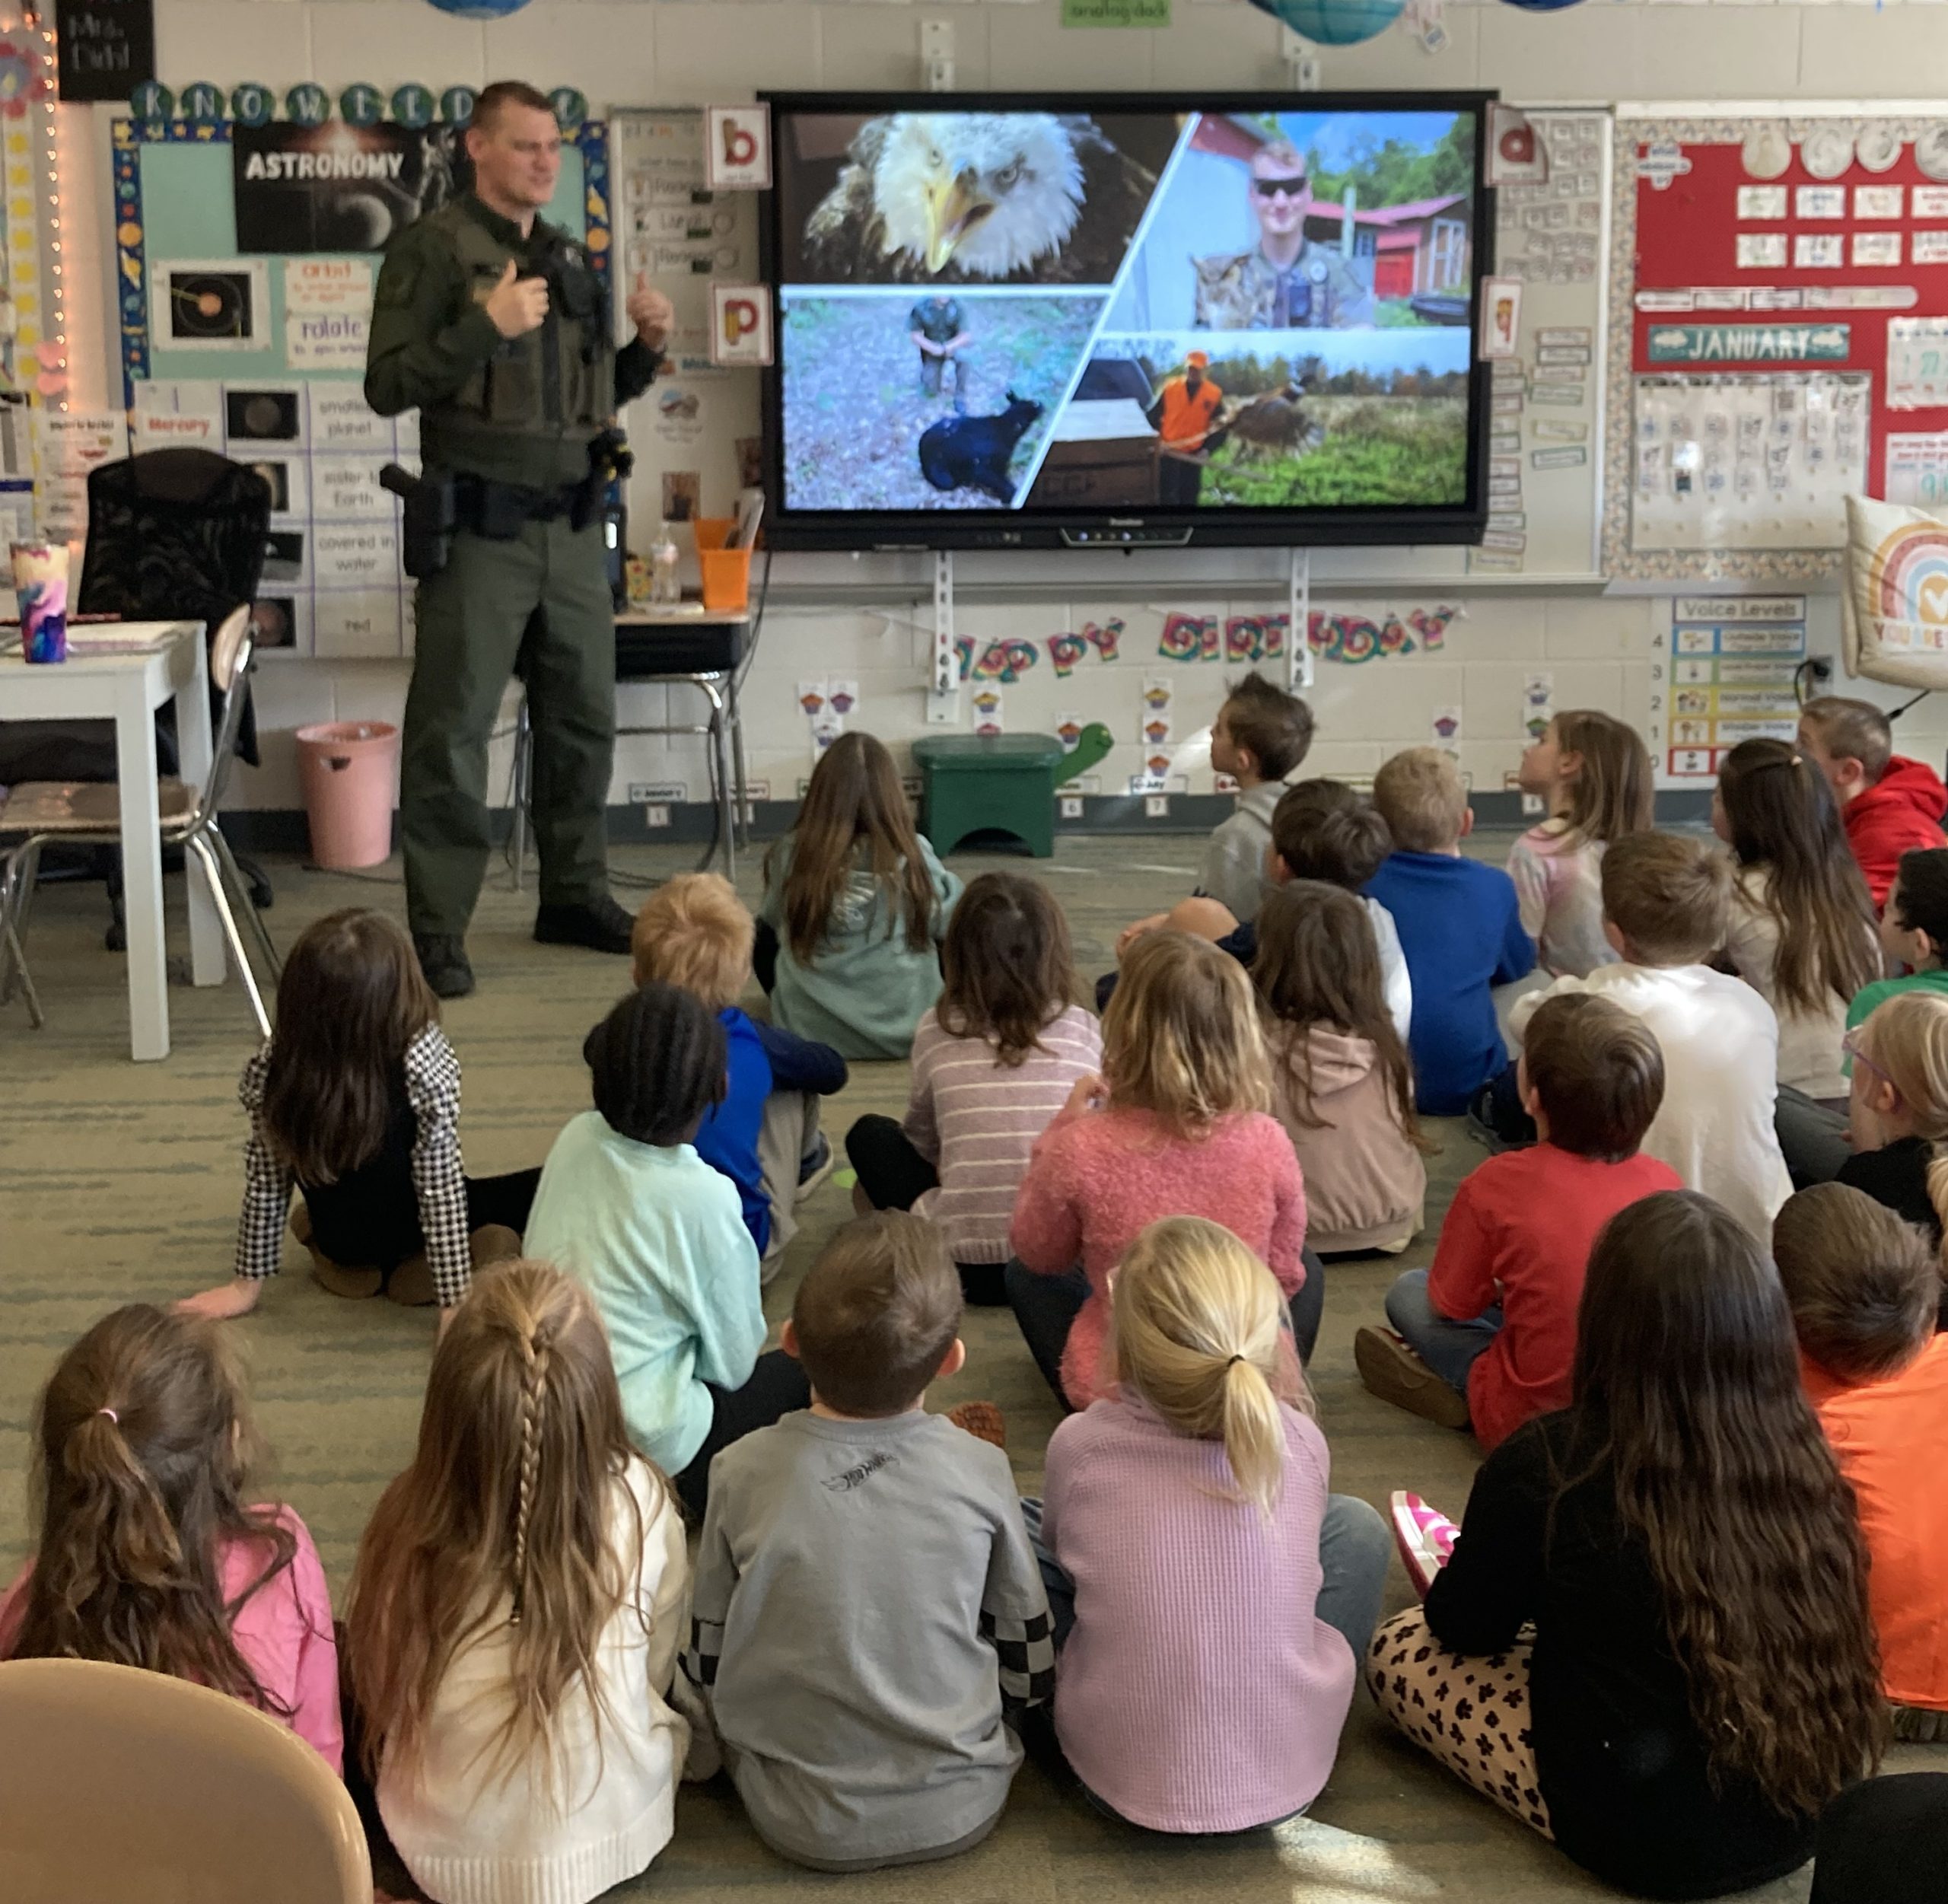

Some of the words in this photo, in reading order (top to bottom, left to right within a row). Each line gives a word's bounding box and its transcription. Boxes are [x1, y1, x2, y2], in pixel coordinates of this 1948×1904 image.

[245, 152, 405, 181] ASTRONOMY
[302, 314, 361, 340] rotate
[1689, 328, 1810, 361] JANUARY
[148, 416, 210, 438] Mercury
[318, 535, 376, 552] covered
[336, 556, 377, 572] water
[1682, 600, 1736, 618] Voice
[1740, 599, 1797, 617] Levels
[345, 619, 371, 633] red
[1653, 634, 1663, 648] 4
[1653, 665, 1663, 680] 3
[1651, 696, 1661, 712] 2
[1652, 725, 1659, 738] 1
[1068, 803, 1077, 815] 6
[1153, 801, 1161, 814] 7
